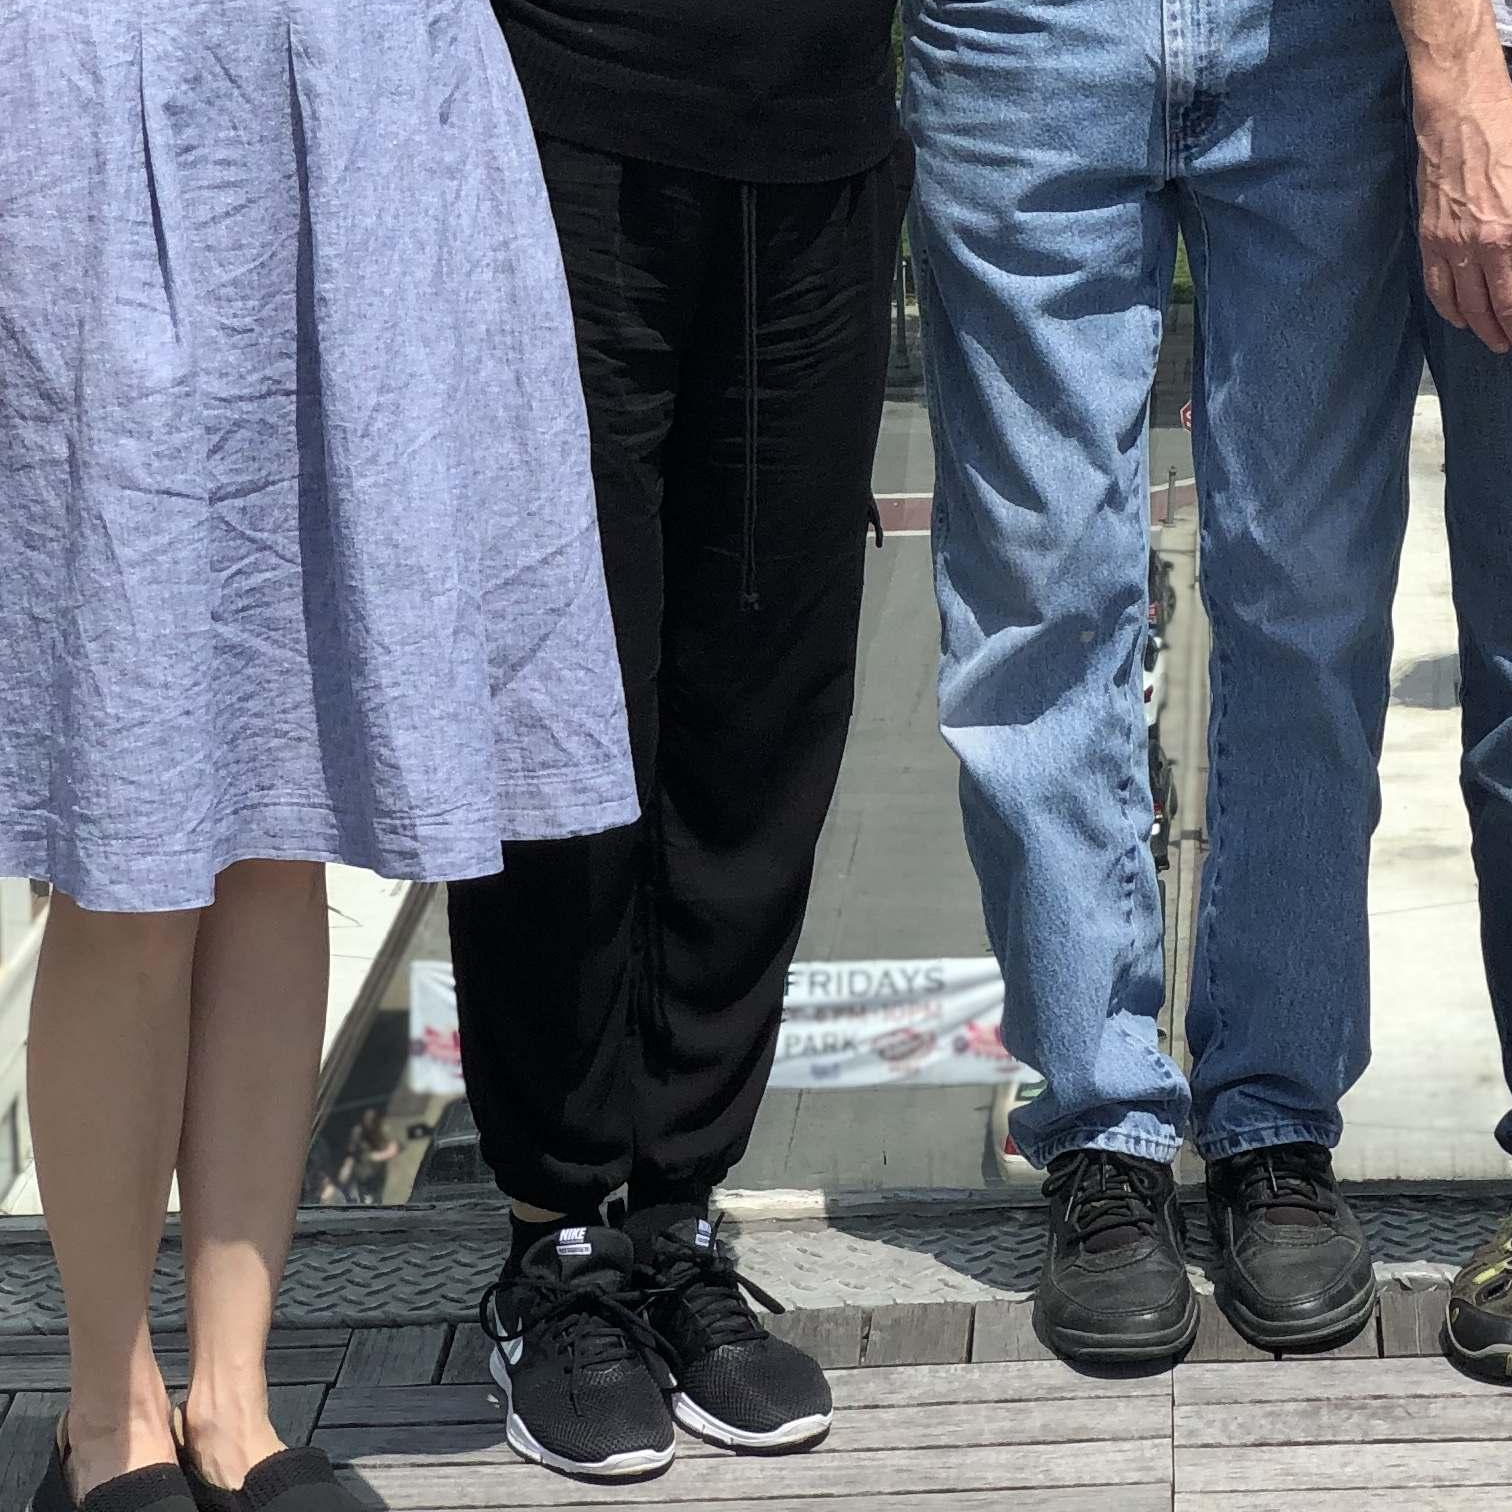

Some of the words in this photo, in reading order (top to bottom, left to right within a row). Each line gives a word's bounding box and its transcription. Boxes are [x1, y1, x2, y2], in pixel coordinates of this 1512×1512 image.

[783, 967, 945, 998] FRIDAYS
[784, 1031, 858, 1058] PARK
[559, 1227, 587, 1240] NIKE
